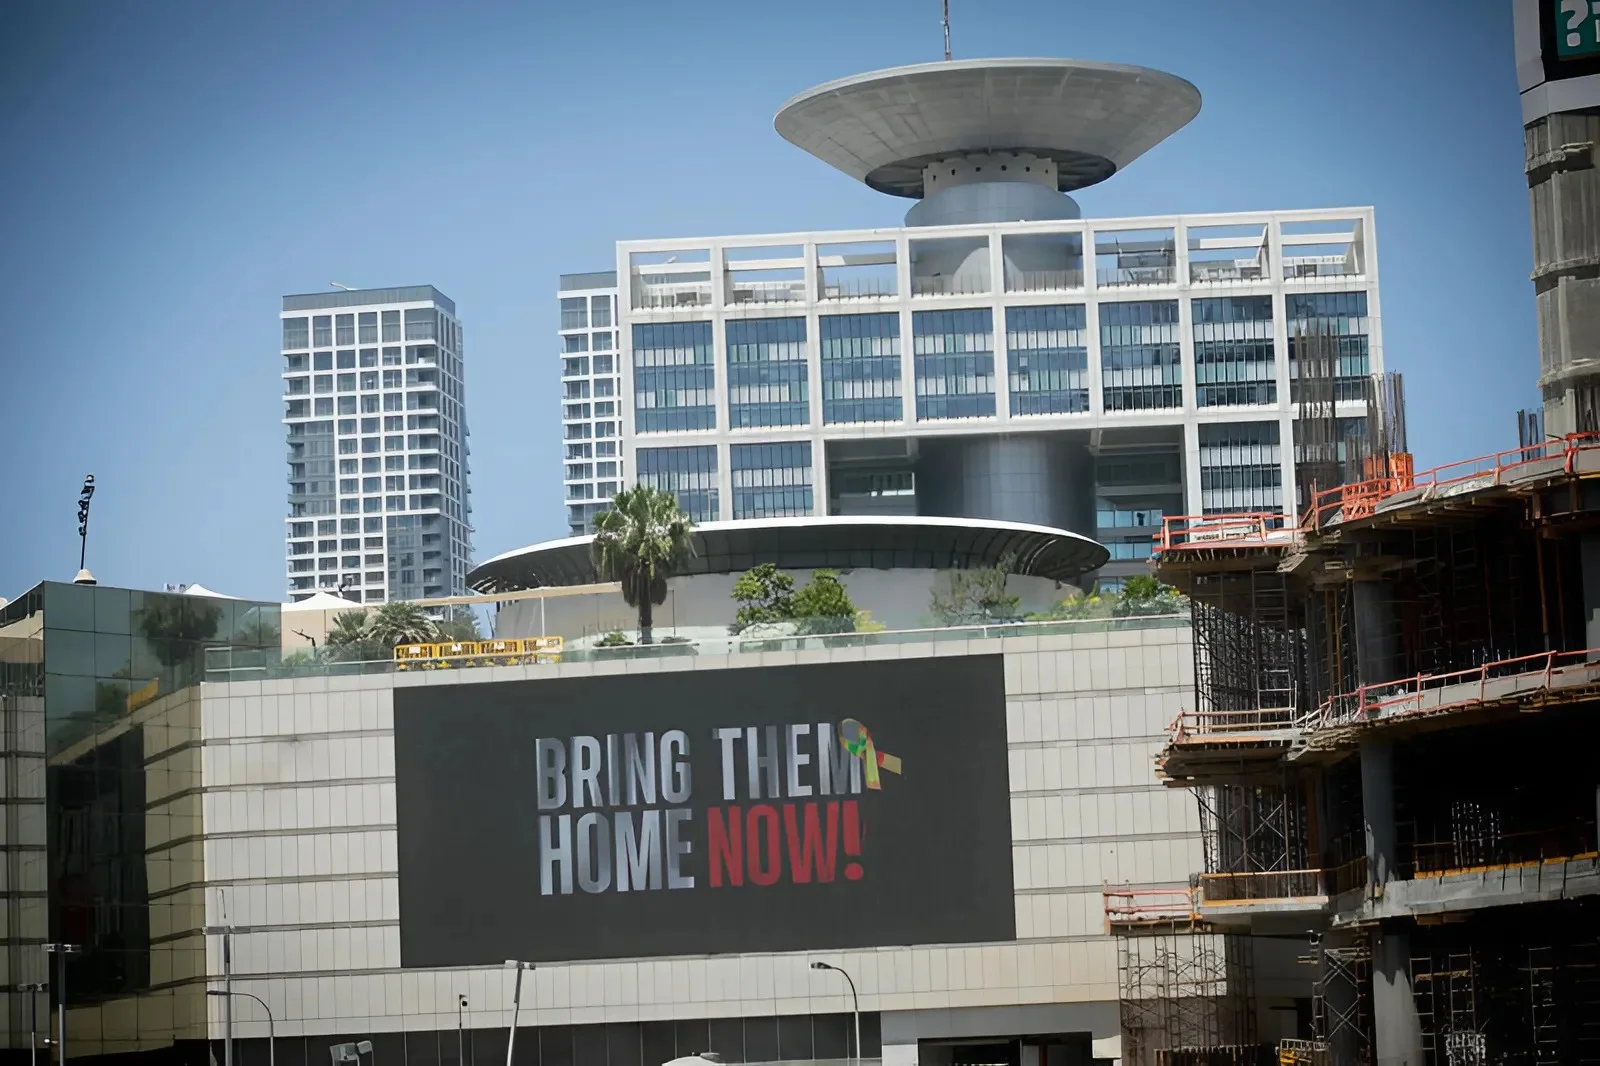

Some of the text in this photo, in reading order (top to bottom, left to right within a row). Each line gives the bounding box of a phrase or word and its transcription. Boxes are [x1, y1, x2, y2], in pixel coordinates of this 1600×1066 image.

[535, 722, 862, 810] BRING THEM
[537, 800, 864, 896] HOME NOW!
